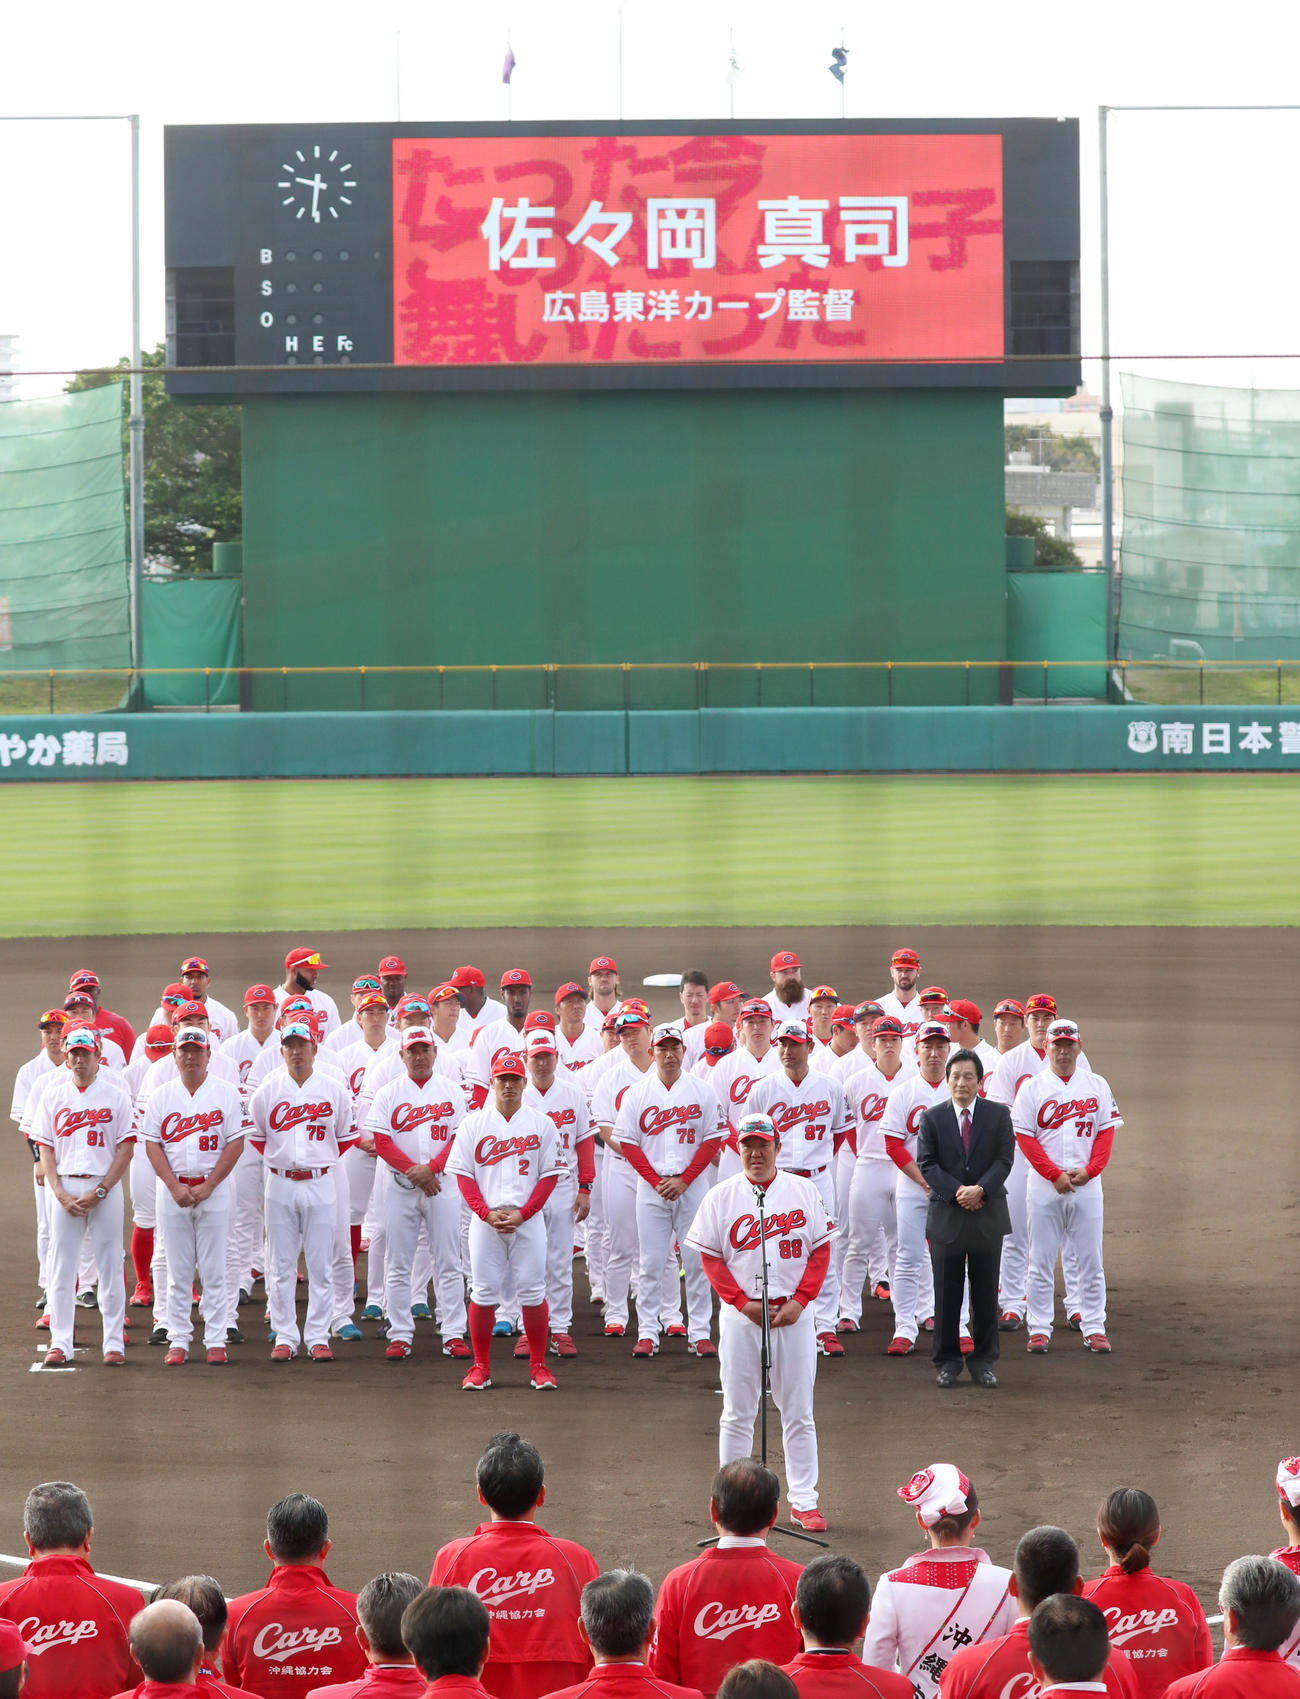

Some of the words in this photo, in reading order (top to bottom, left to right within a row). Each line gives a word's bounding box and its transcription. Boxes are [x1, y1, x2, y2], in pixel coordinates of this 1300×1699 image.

[481, 197, 717, 271] 佐々岡
[757, 195, 909, 269] 真司
[259, 248, 273, 265] B
[260, 279, 273, 297] S
[542, 287, 855, 323] 広島東洋カープ監督
[285, 336, 299, 352] H
[312, 336, 325, 352] E
[0, 730, 129, 767] やか薬局
[55, 1107, 113, 1138] Carp
[268, 1100, 333, 1132] Carp
[390, 1101, 455, 1133] Carp
[639, 1103, 703, 1137] Carp
[767, 1100, 831, 1133] Carp
[861, 1093, 889, 1122] Ca
[1037, 1098, 1099, 1130] Carp
[86, 1130, 105, 1148] 81
[160, 1109, 224, 1144] Carp
[304, 1124, 327, 1141] 75
[430, 1123, 448, 1141] 80
[804, 1124, 826, 1141] 87
[1075, 1121, 1093, 1138] 73
[198, 1134, 219, 1152] 83
[474, 1134, 541, 1168] Carp
[518, 1159, 530, 1176] 2
[729, 1208, 807, 1253] Carp
[778, 1239, 803, 1260] 88
[468, 1567, 555, 1607] Carp
[694, 1601, 781, 1641] Carp
[253, 1622, 342, 1663] Carp
[1123, 1648, 1169, 1660] 協力会
[268, 1665, 333, 1676] 沖縄協力会
